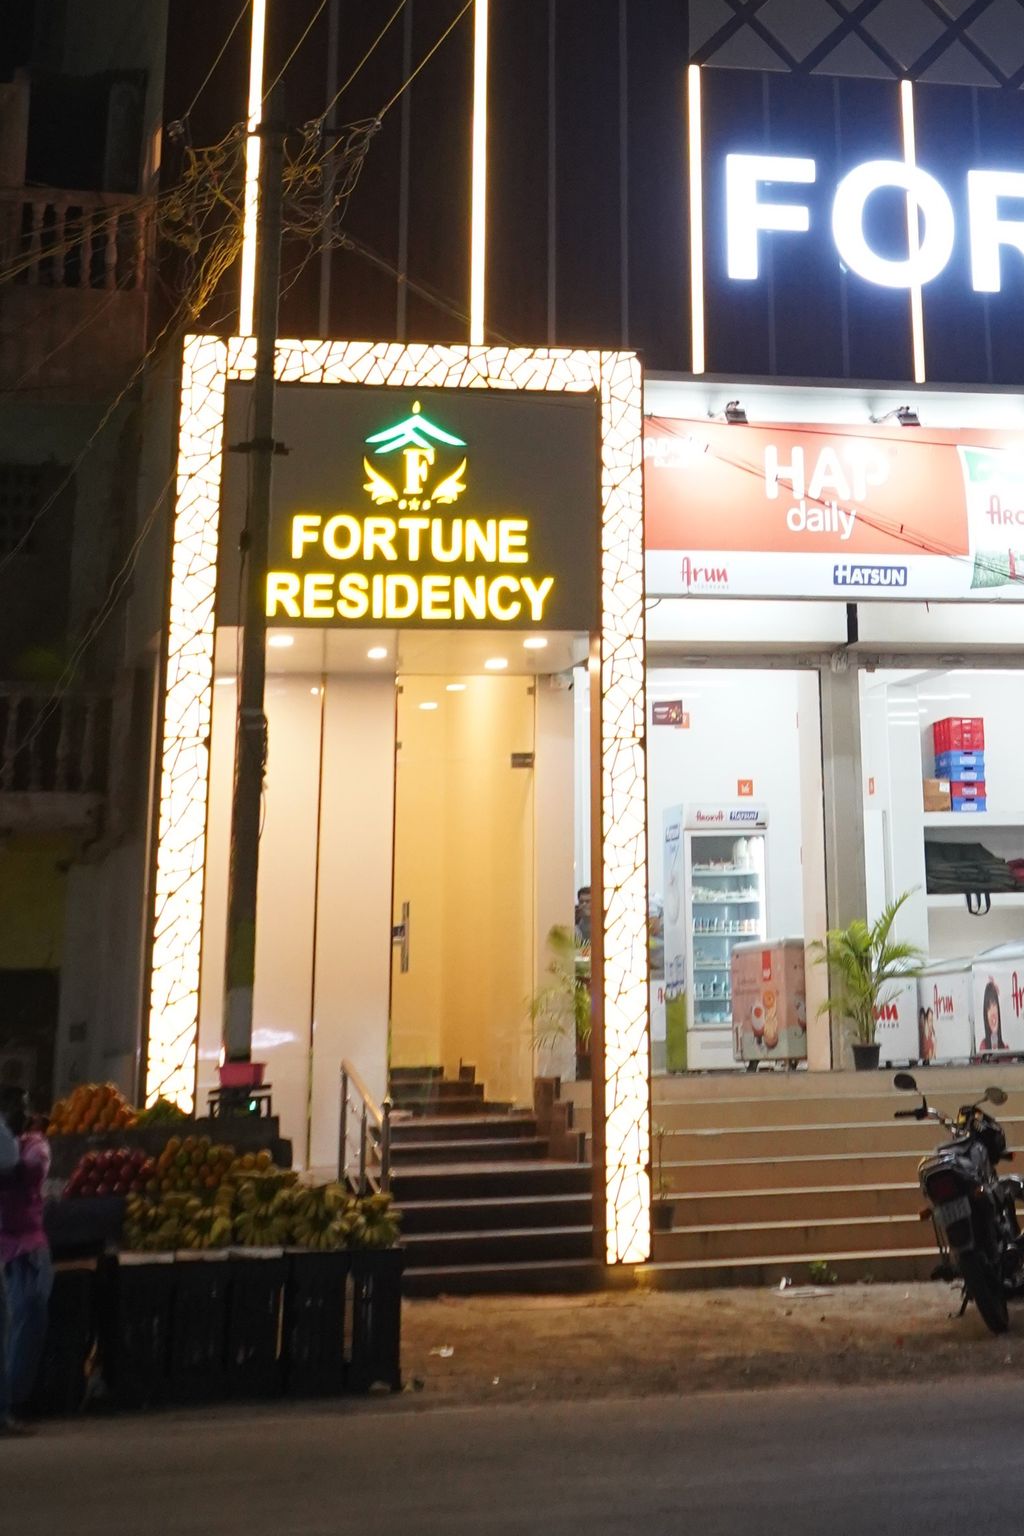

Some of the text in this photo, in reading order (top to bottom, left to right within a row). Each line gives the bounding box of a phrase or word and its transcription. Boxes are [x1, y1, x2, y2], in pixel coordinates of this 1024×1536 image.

[764, 442, 890, 502] HAP
[290, 514, 529, 563] FORTUNE
[786, 501, 857, 540] daily
[680, 556, 728, 586] Arun
[834, 565, 906, 586] HATSUN
[266, 573, 554, 621] RESIDENCY
[934, 984, 954, 1020] Arun
